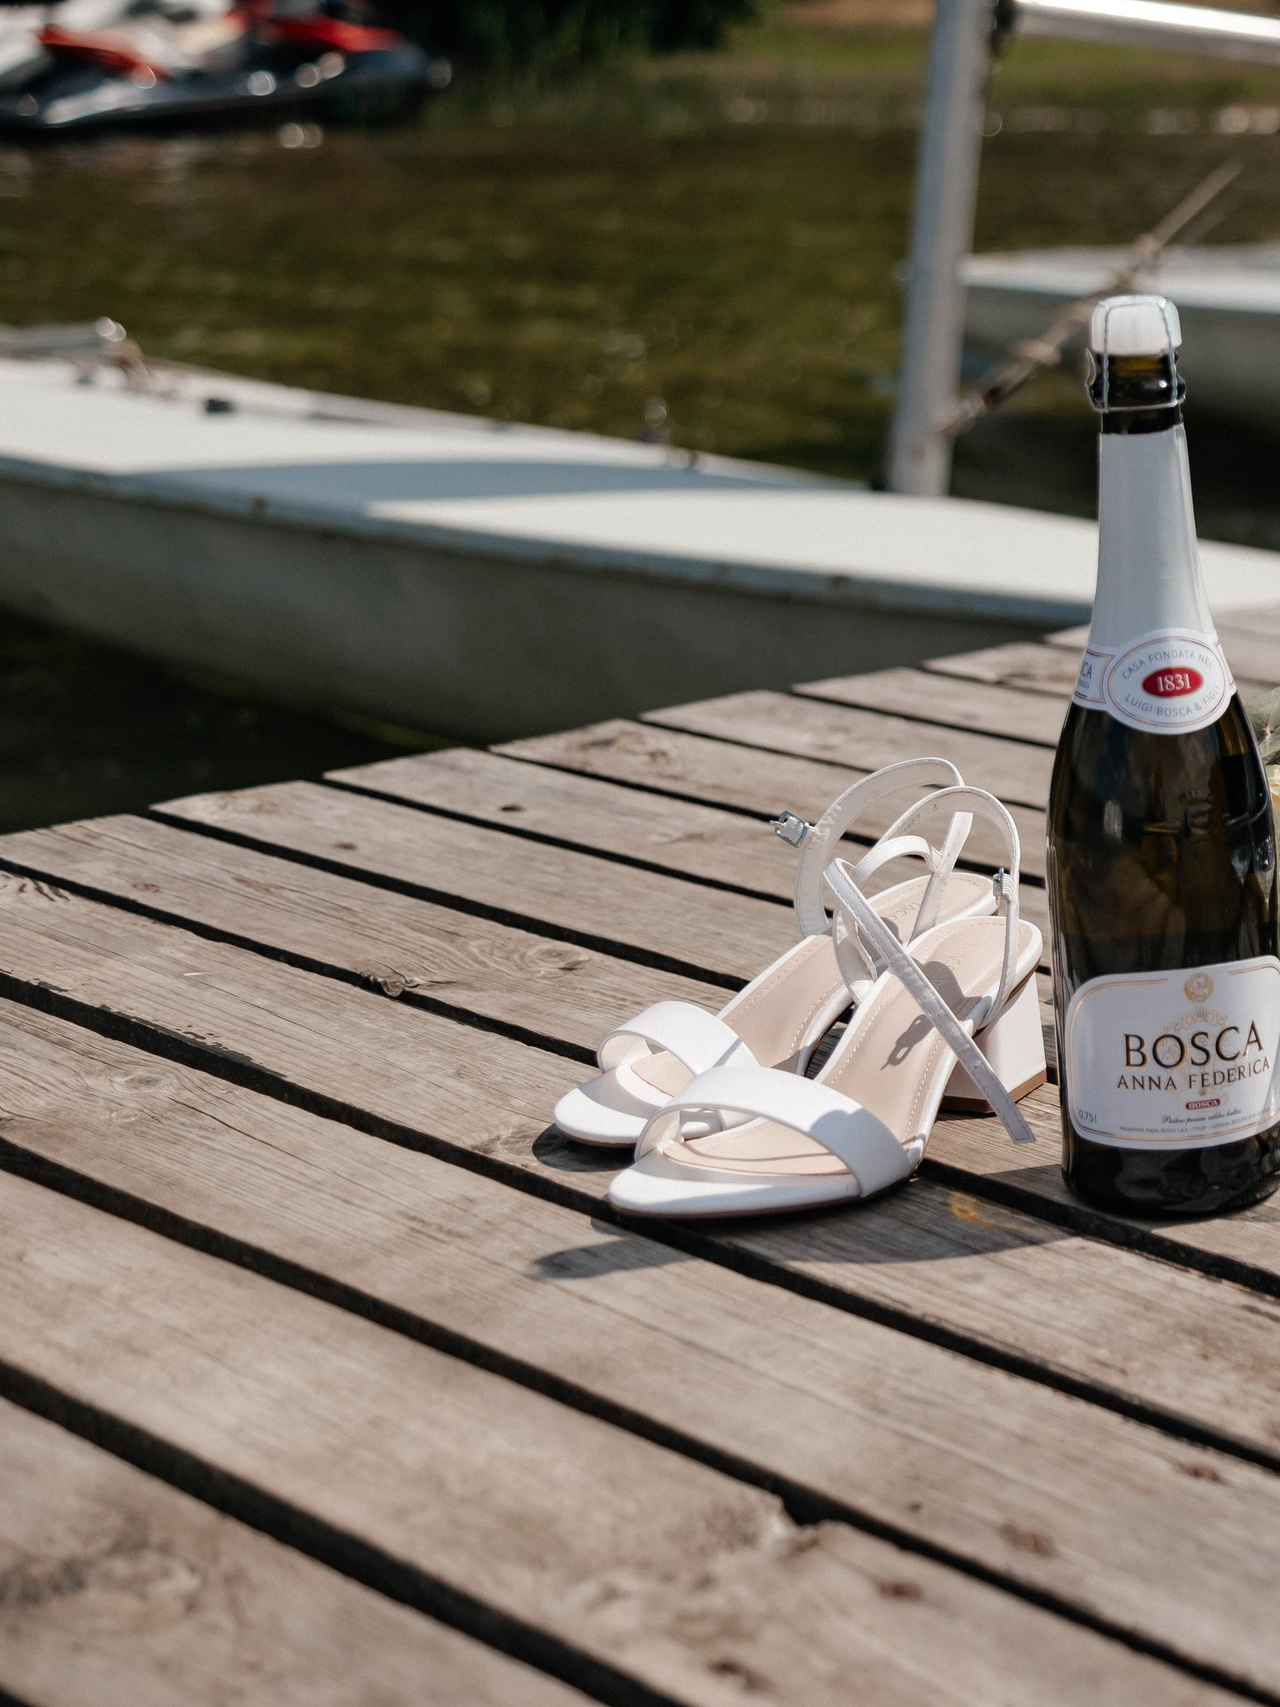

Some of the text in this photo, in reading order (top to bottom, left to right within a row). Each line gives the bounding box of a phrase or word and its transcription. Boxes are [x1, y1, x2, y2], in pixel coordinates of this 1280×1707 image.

[1122, 649, 1215, 680] CASA FONDATA NEL
[1157, 673, 1191, 692] 1831
[1124, 684, 1221, 718] LUIGI BOSCA & FIGLI
[1124, 1020, 1264, 1069] BOSCA
[1117, 1056, 1270, 1091] ANNA FEDERICA
[1187, 1100, 1218, 1109] BOSCA
